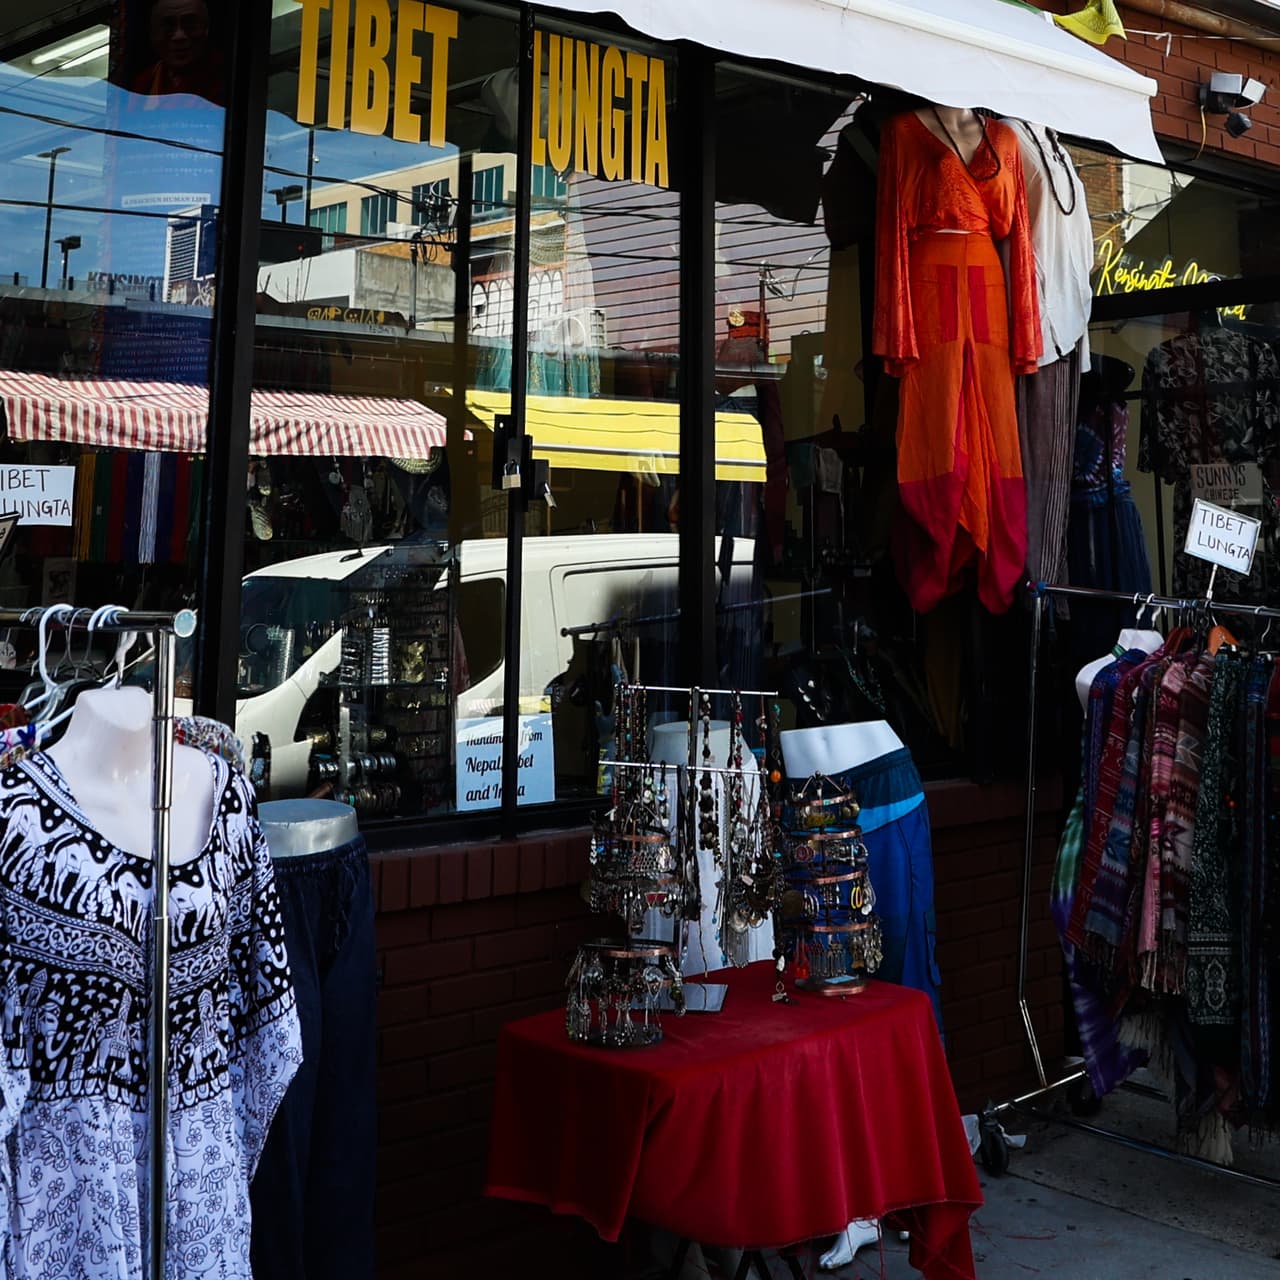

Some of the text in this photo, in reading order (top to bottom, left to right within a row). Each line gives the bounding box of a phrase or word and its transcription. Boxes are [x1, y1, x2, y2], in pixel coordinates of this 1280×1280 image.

[531, 30, 669, 188] LUNGTA
[1200, 508, 1247, 535] TIBET
[1197, 530, 1251, 560] LUNGTA
[466, 784, 490, 802] and
